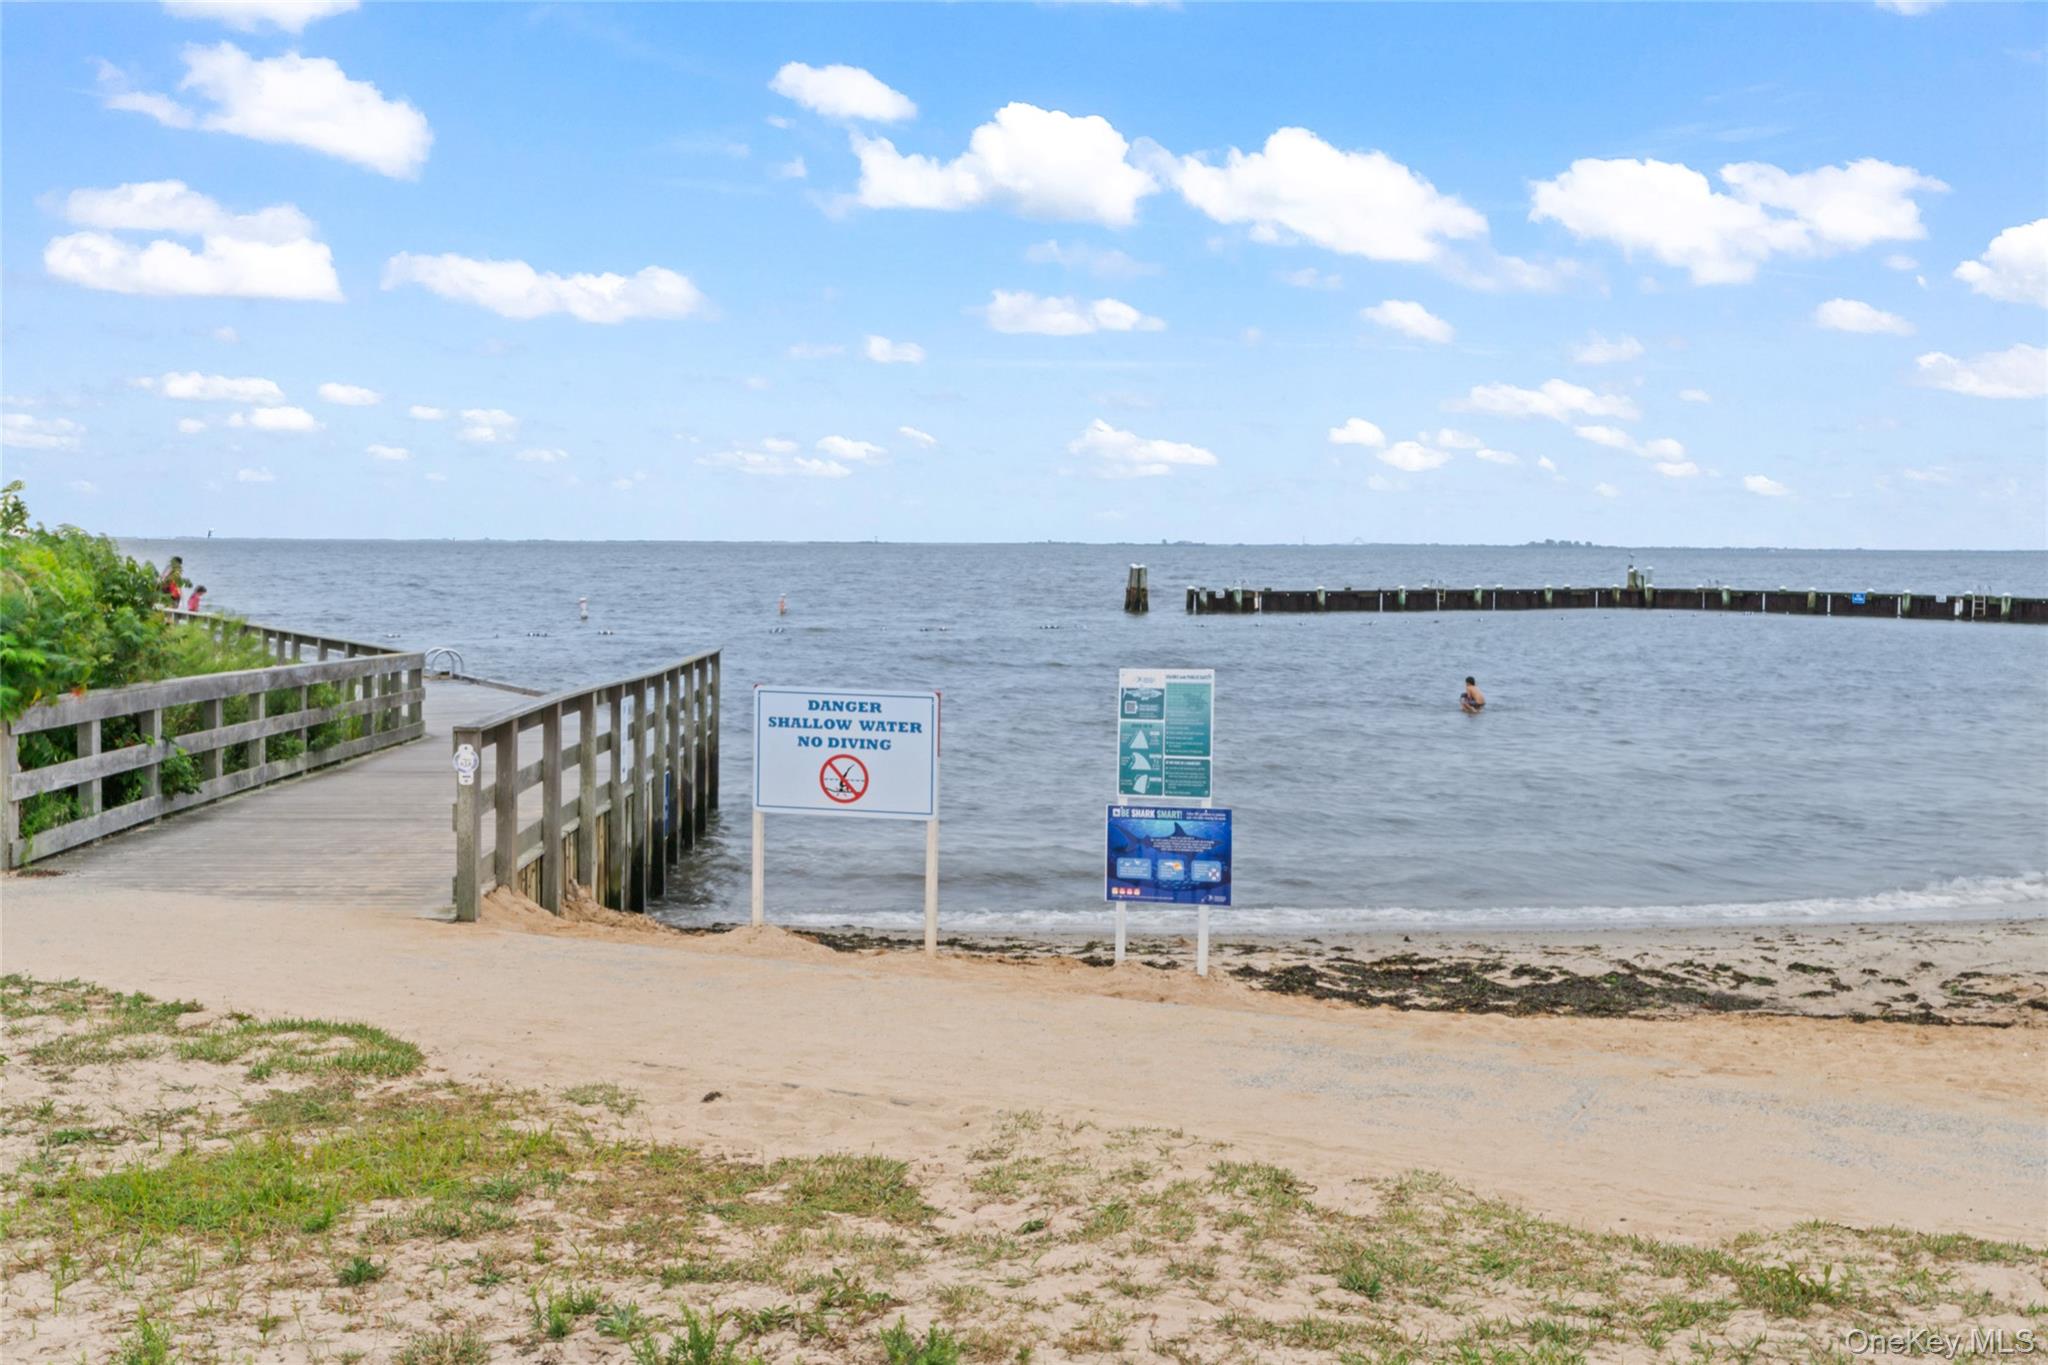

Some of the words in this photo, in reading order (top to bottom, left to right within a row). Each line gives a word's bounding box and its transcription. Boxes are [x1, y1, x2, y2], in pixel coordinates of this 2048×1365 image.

[808, 700, 882, 713] DANGER
[768, 717, 852, 731] SHALLOW
[859, 720, 923, 733] WATER
[797, 736, 823, 747] NO
[828, 737, 892, 750] DIVING
[1121, 808, 1130, 817] BE
[1131, 808, 1155, 818] SHARK
[1156, 809, 1183, 819] SMART!
